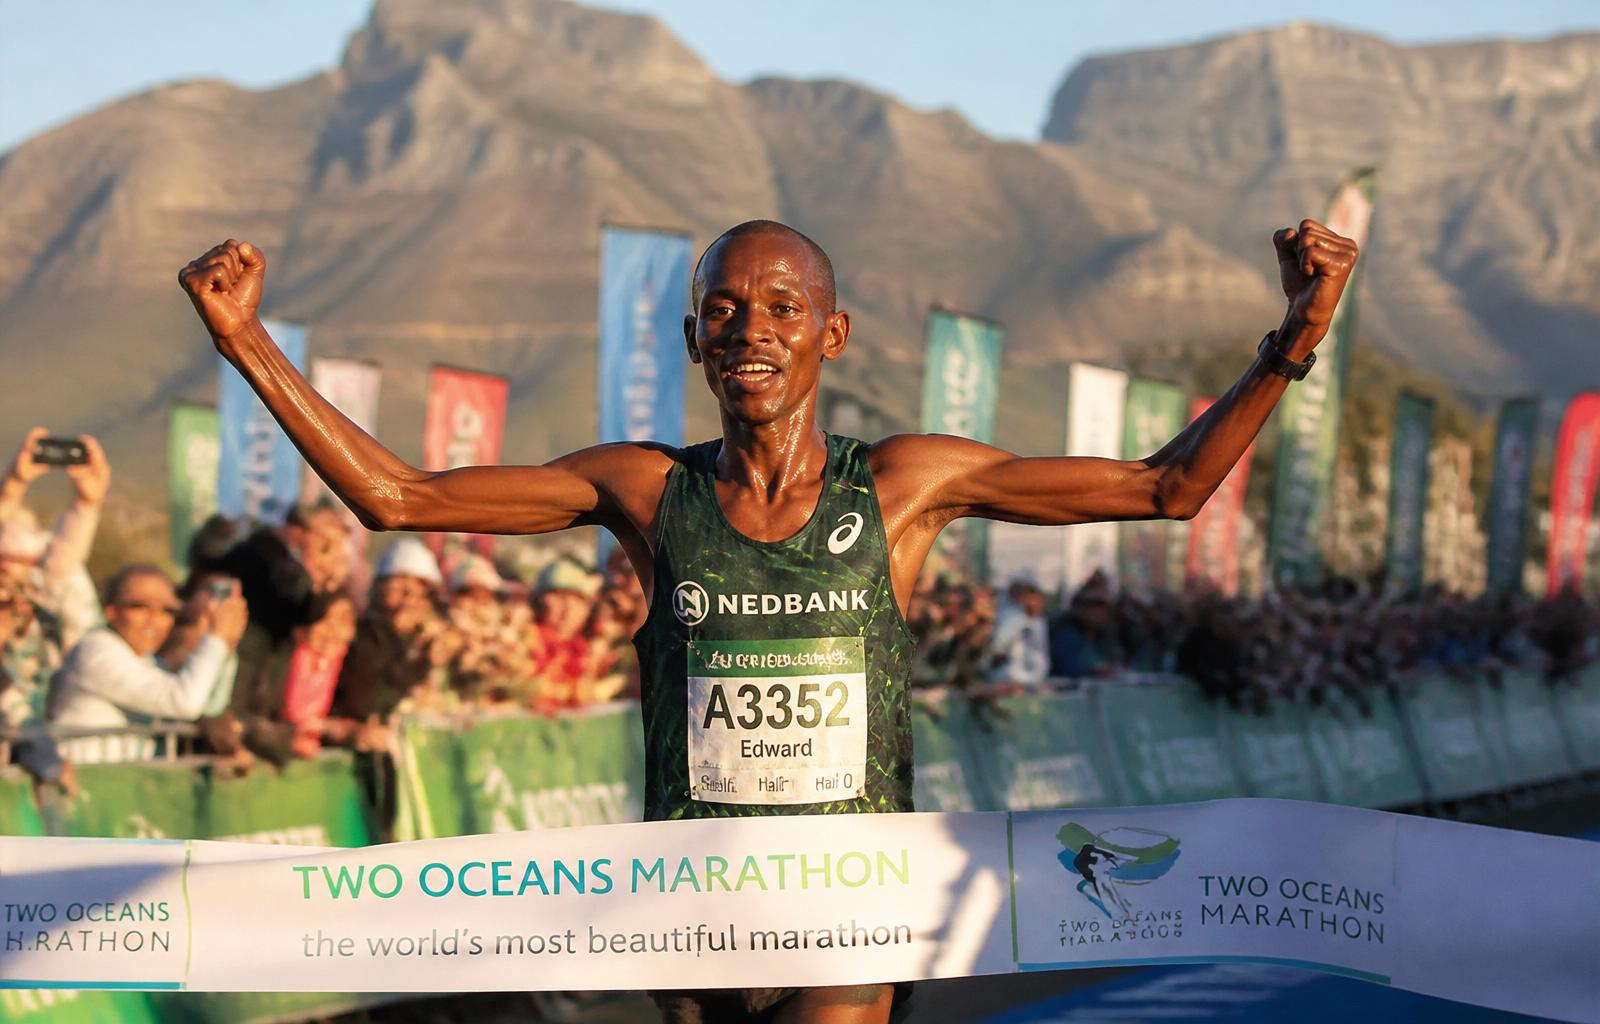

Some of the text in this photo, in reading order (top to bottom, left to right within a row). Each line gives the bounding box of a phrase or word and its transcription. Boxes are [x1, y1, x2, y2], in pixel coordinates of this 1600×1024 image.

[717, 589, 870, 615] NEDBANK
[702, 680, 850, 730] A3352
[740, 738, 813, 758] Edward
[292, 848, 910, 899] TWO OCEANS MARATHON
[5, 901, 170, 923] TWO OCEANS
[1198, 875, 1385, 914] TWO OCEANS
[301, 919, 912, 958] the world's most beautiful marathon
[1201, 903, 1385, 945] MARATHON
